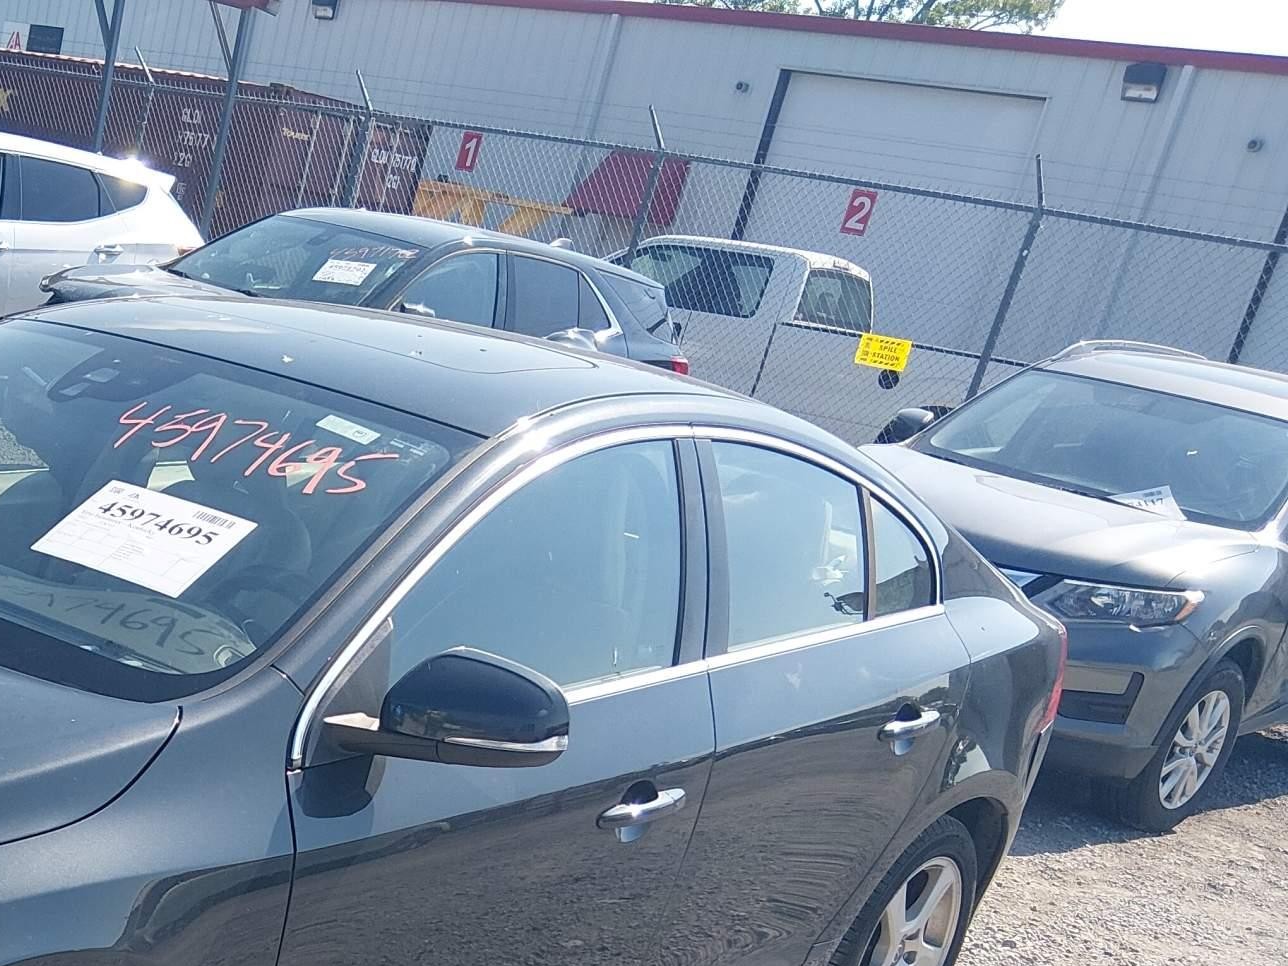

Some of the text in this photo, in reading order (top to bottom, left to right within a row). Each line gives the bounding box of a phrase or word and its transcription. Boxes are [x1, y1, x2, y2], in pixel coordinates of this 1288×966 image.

[465, 137, 477, 167] 1
[845, 196, 871, 231] 2
[871, 351, 900, 362] STATION
[879, 344, 898, 354] SPILL
[113, 401, 400, 495] 45974695
[98, 501, 220, 546] 45974695
